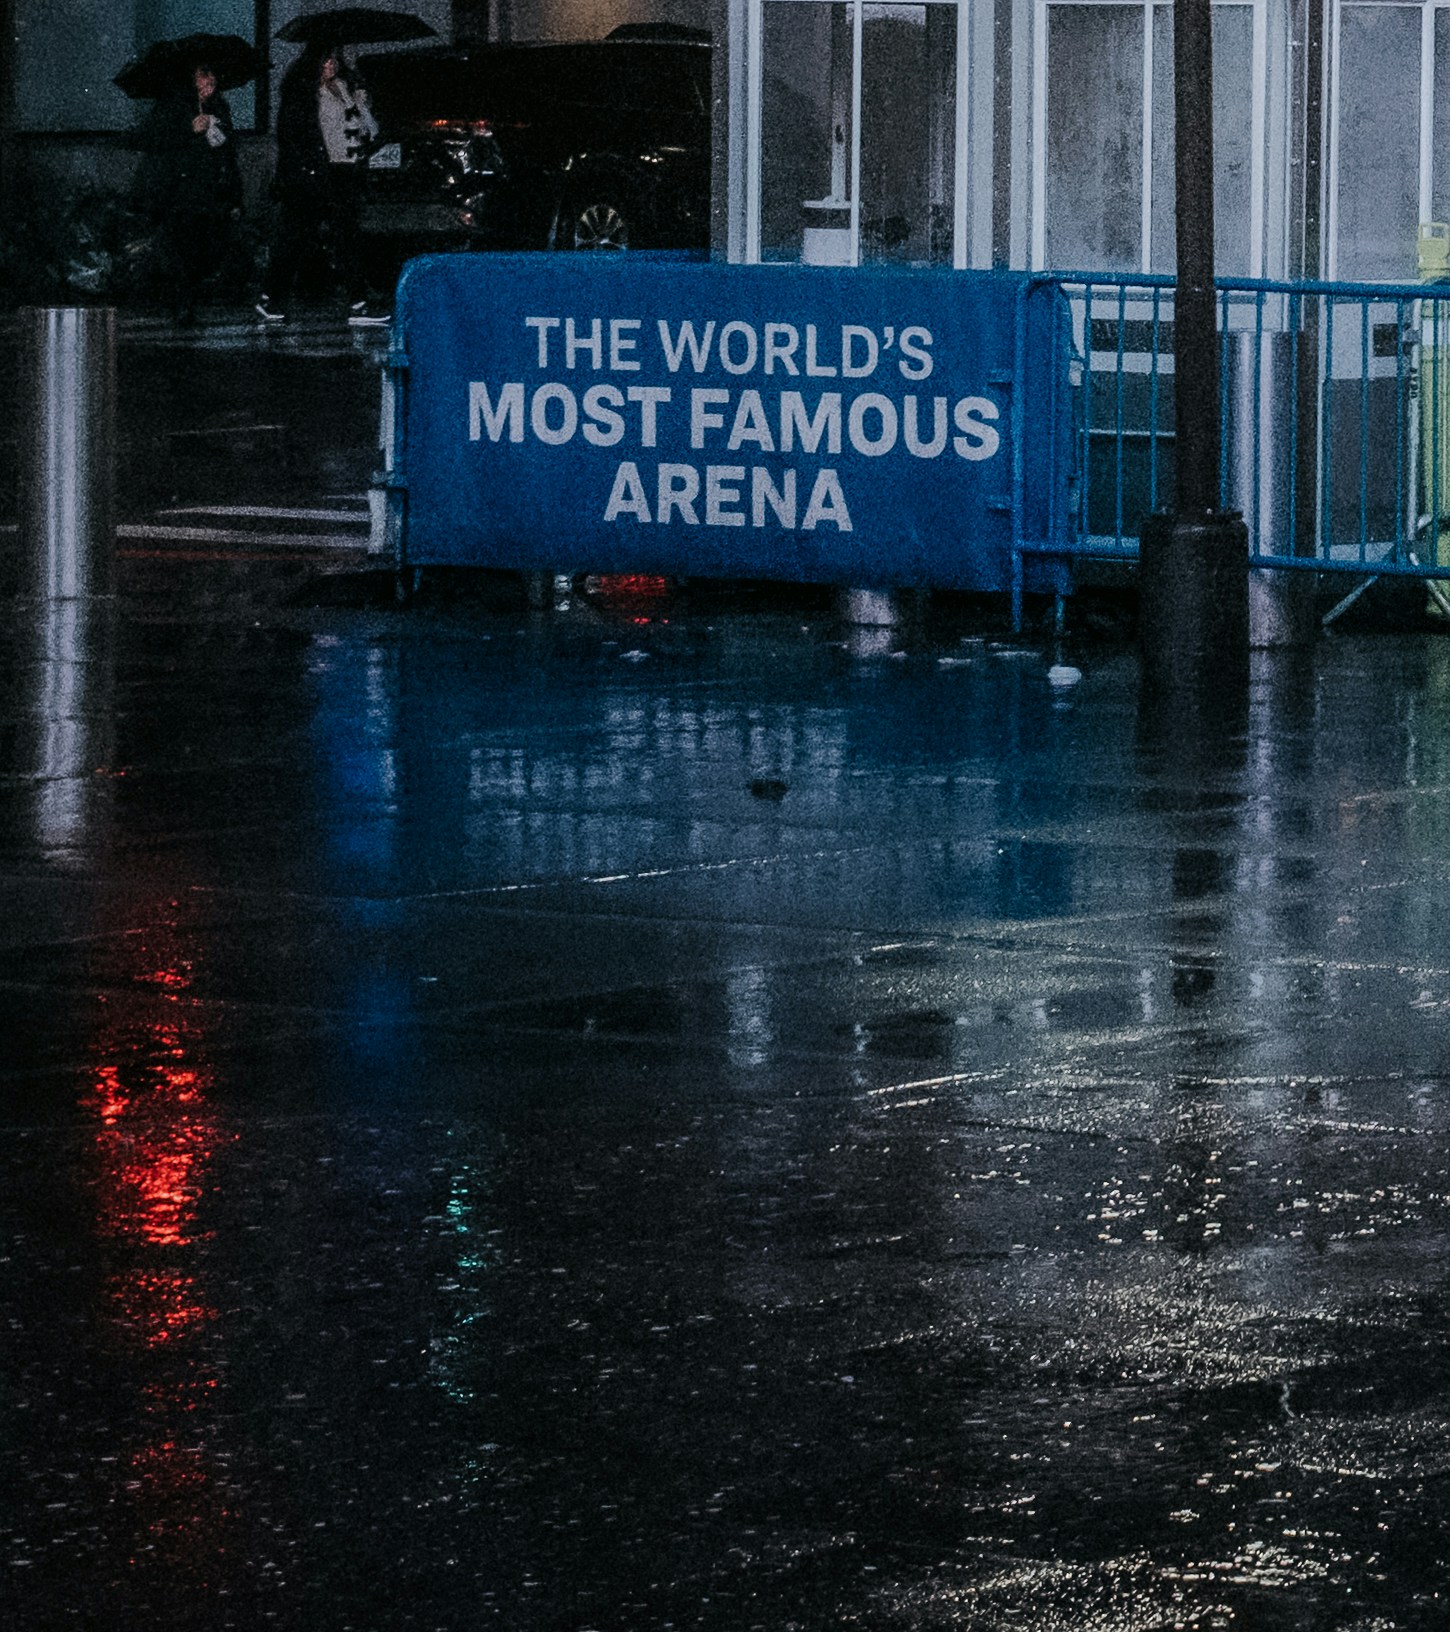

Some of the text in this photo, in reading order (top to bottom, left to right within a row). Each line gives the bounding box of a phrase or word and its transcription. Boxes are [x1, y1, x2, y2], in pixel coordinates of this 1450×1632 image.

[525, 316, 935, 381] THE WORLD'S
[468, 380, 1001, 462] MOST FAMOUS
[603, 460, 854, 533] ARENA
